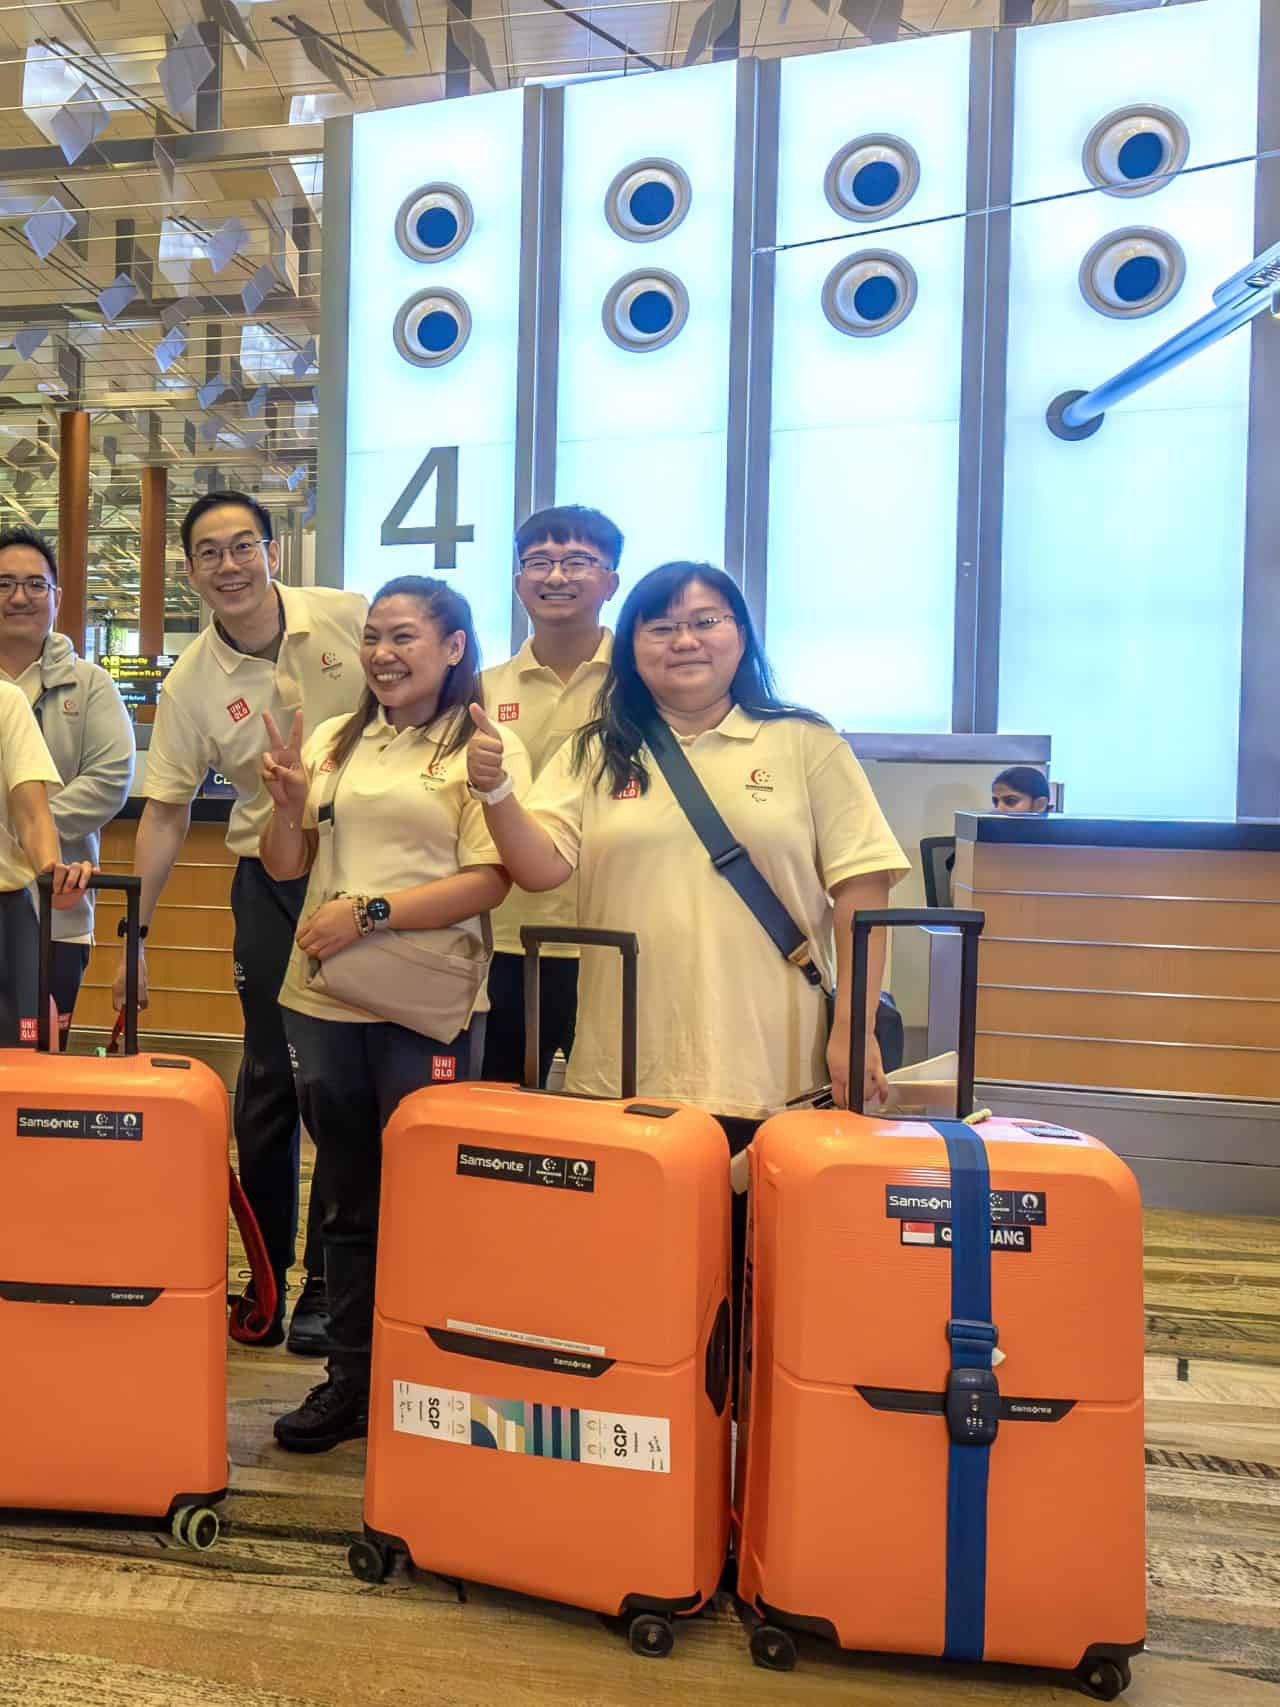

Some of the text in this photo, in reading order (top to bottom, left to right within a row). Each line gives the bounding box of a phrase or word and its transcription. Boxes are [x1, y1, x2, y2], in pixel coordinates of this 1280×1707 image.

[380, 445, 475, 570] 4
[500, 705, 517, 713] UNI
[500, 712, 517, 721] QLO
[22, 1022, 35, 1030] UNI
[22, 1029, 35, 1039] QLO
[434, 1057, 452, 1068] UNI
[434, 1068, 453, 1079] QLO
[19, 1117, 80, 1129] Samsonite
[459, 1154, 525, 1172] Samsonite
[888, 1195, 953, 1210] Samsoni
[552, 1356, 592, 1370] Samsonite
[428, 1397, 440, 1430] SGP
[1010, 1404, 1052, 1414] Samsonite
[614, 1424, 628, 1457] SGP
